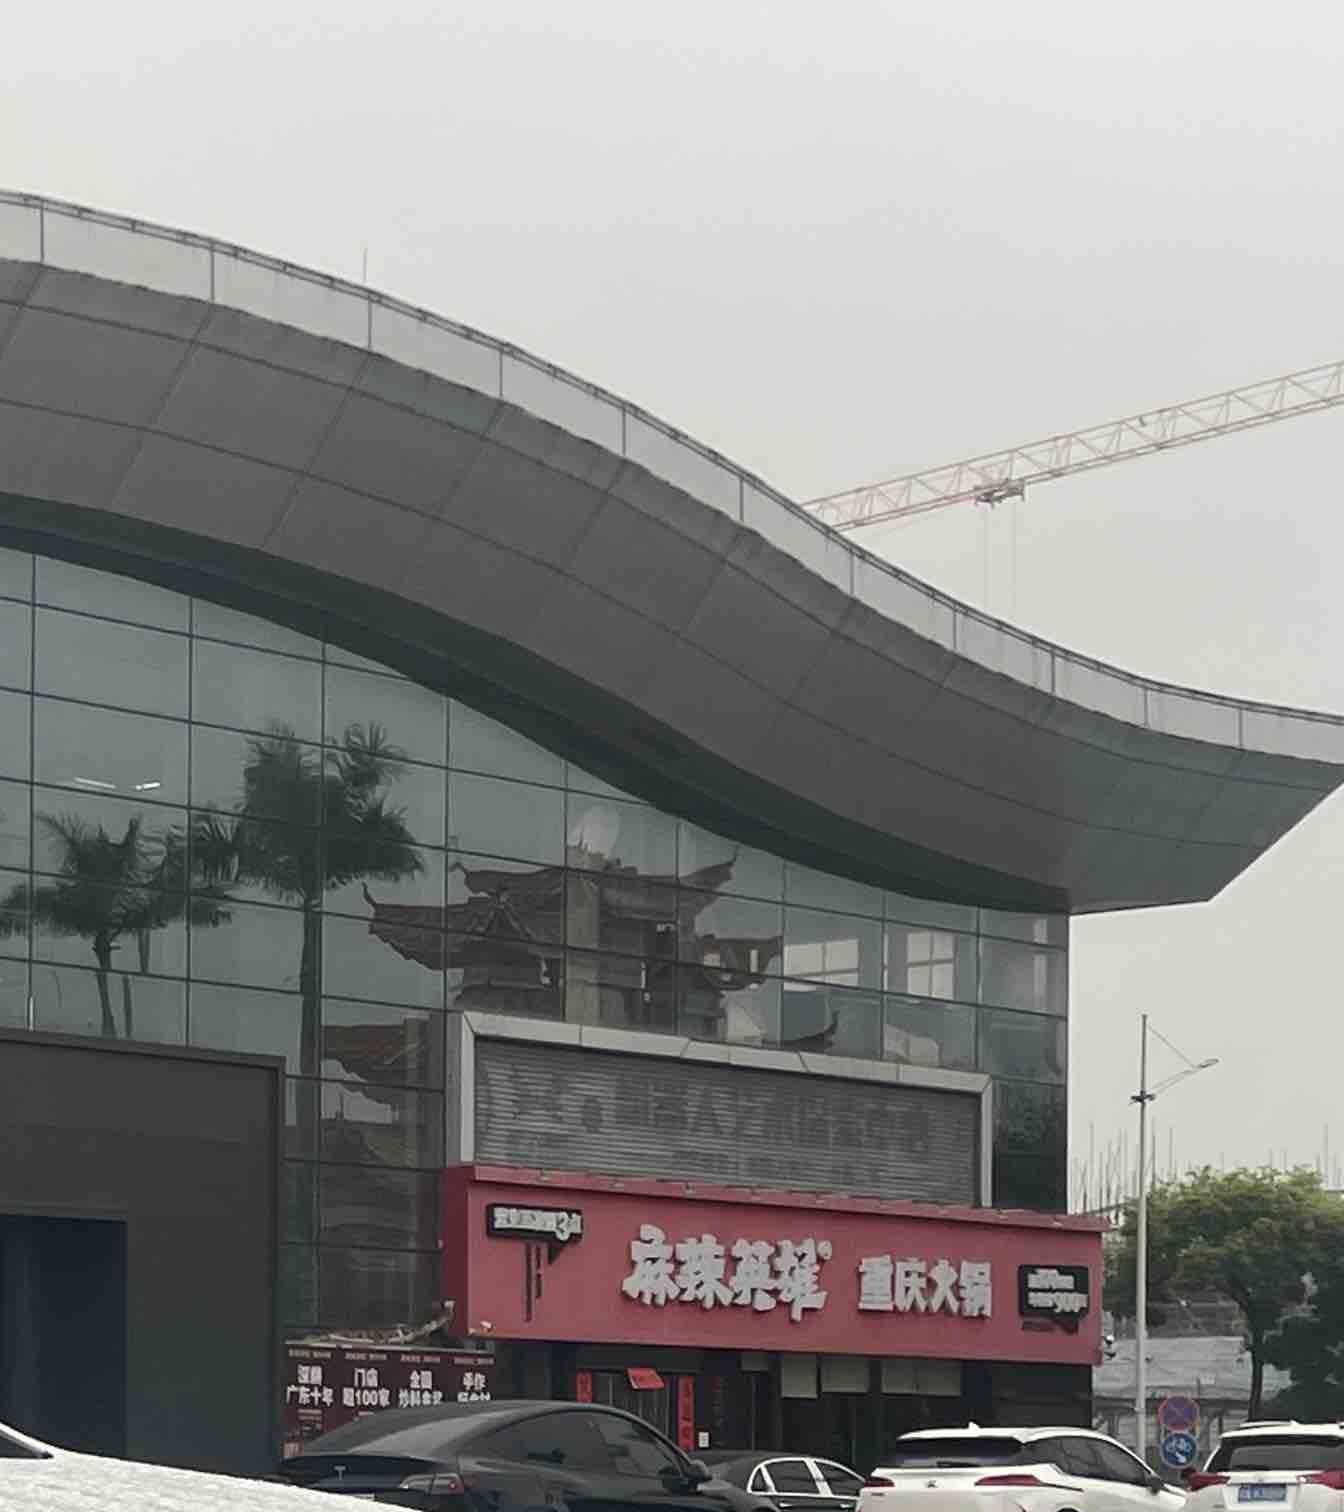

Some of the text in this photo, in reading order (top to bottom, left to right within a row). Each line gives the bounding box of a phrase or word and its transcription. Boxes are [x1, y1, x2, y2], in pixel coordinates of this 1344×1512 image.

[621, 1224, 993, 1323] 麻辣英雄 重庆火锅
